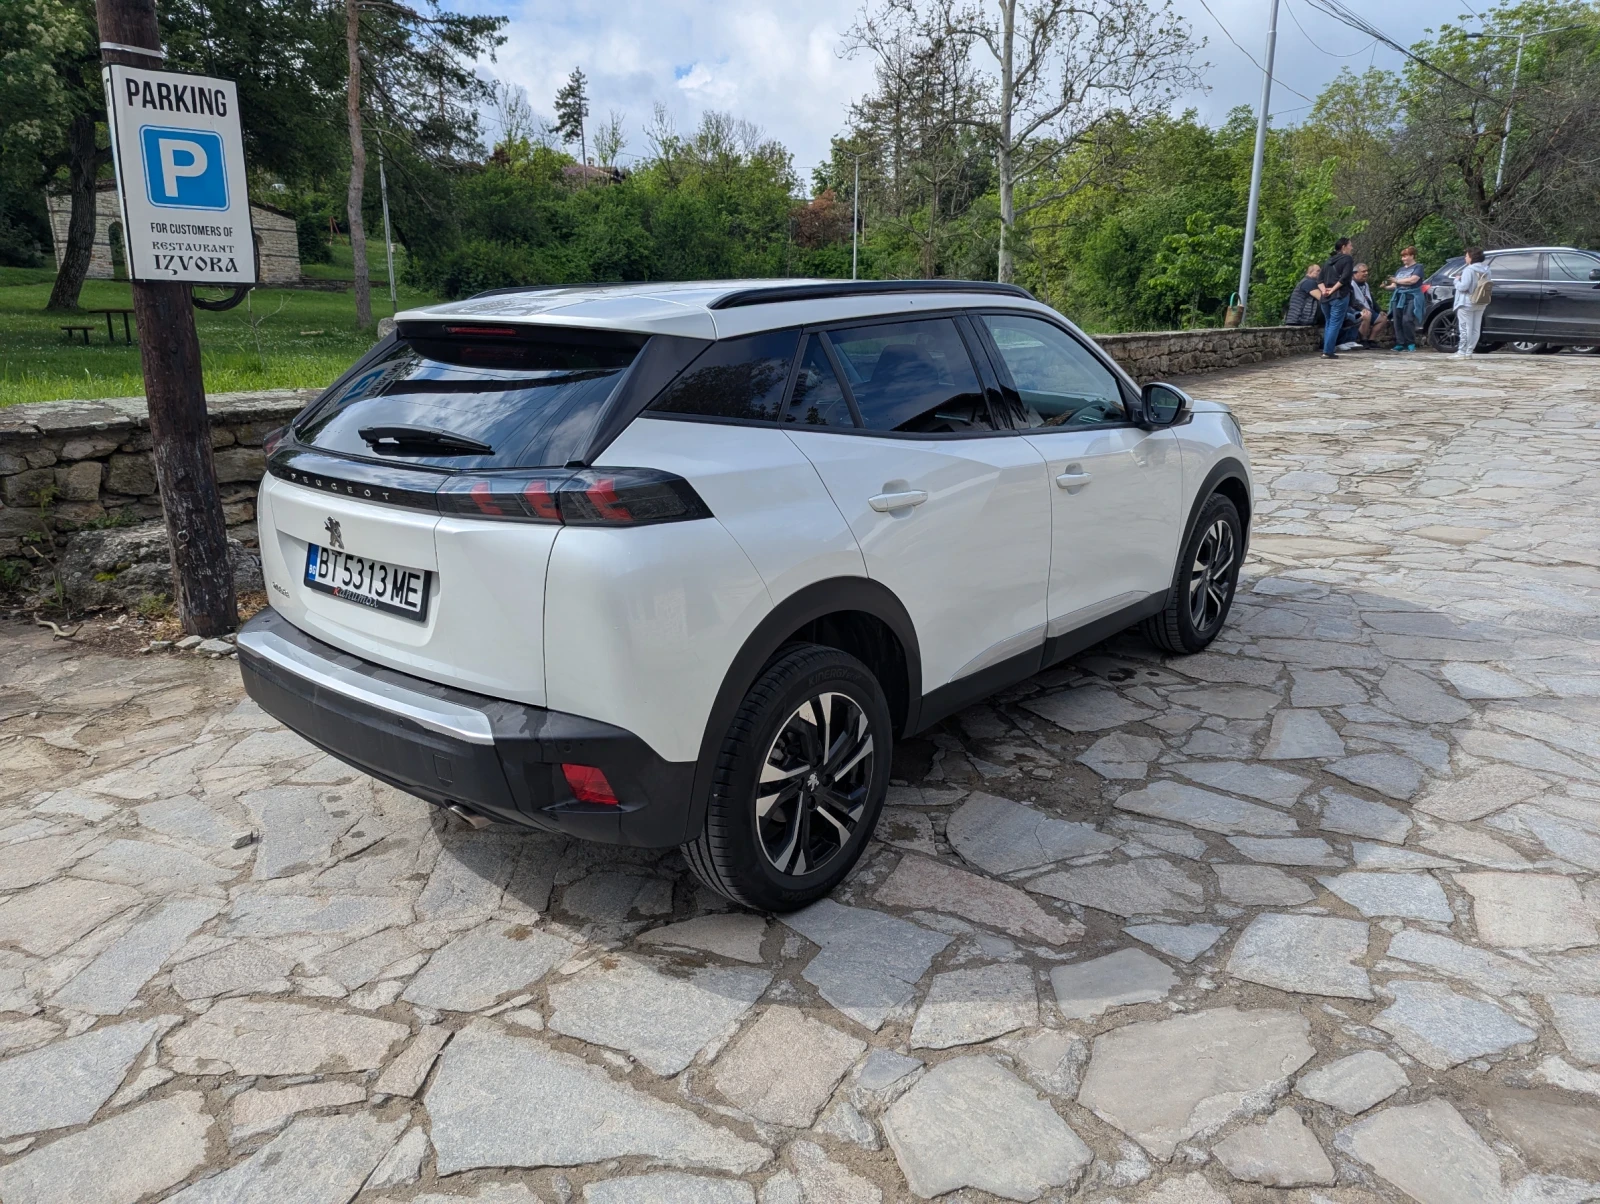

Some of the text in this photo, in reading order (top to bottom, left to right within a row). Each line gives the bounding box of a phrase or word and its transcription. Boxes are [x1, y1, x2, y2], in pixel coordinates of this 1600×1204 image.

[125, 78, 227, 117] PARKING
[158, 138, 208, 198] P
[150, 222, 233, 237] FOR CUSTOMERS OF
[152, 241, 234, 253] RESTAURANT
[153, 254, 239, 275] IZVORA
[291, 473, 389, 500] PEUGEOT
[308, 564, 316, 575] BG
